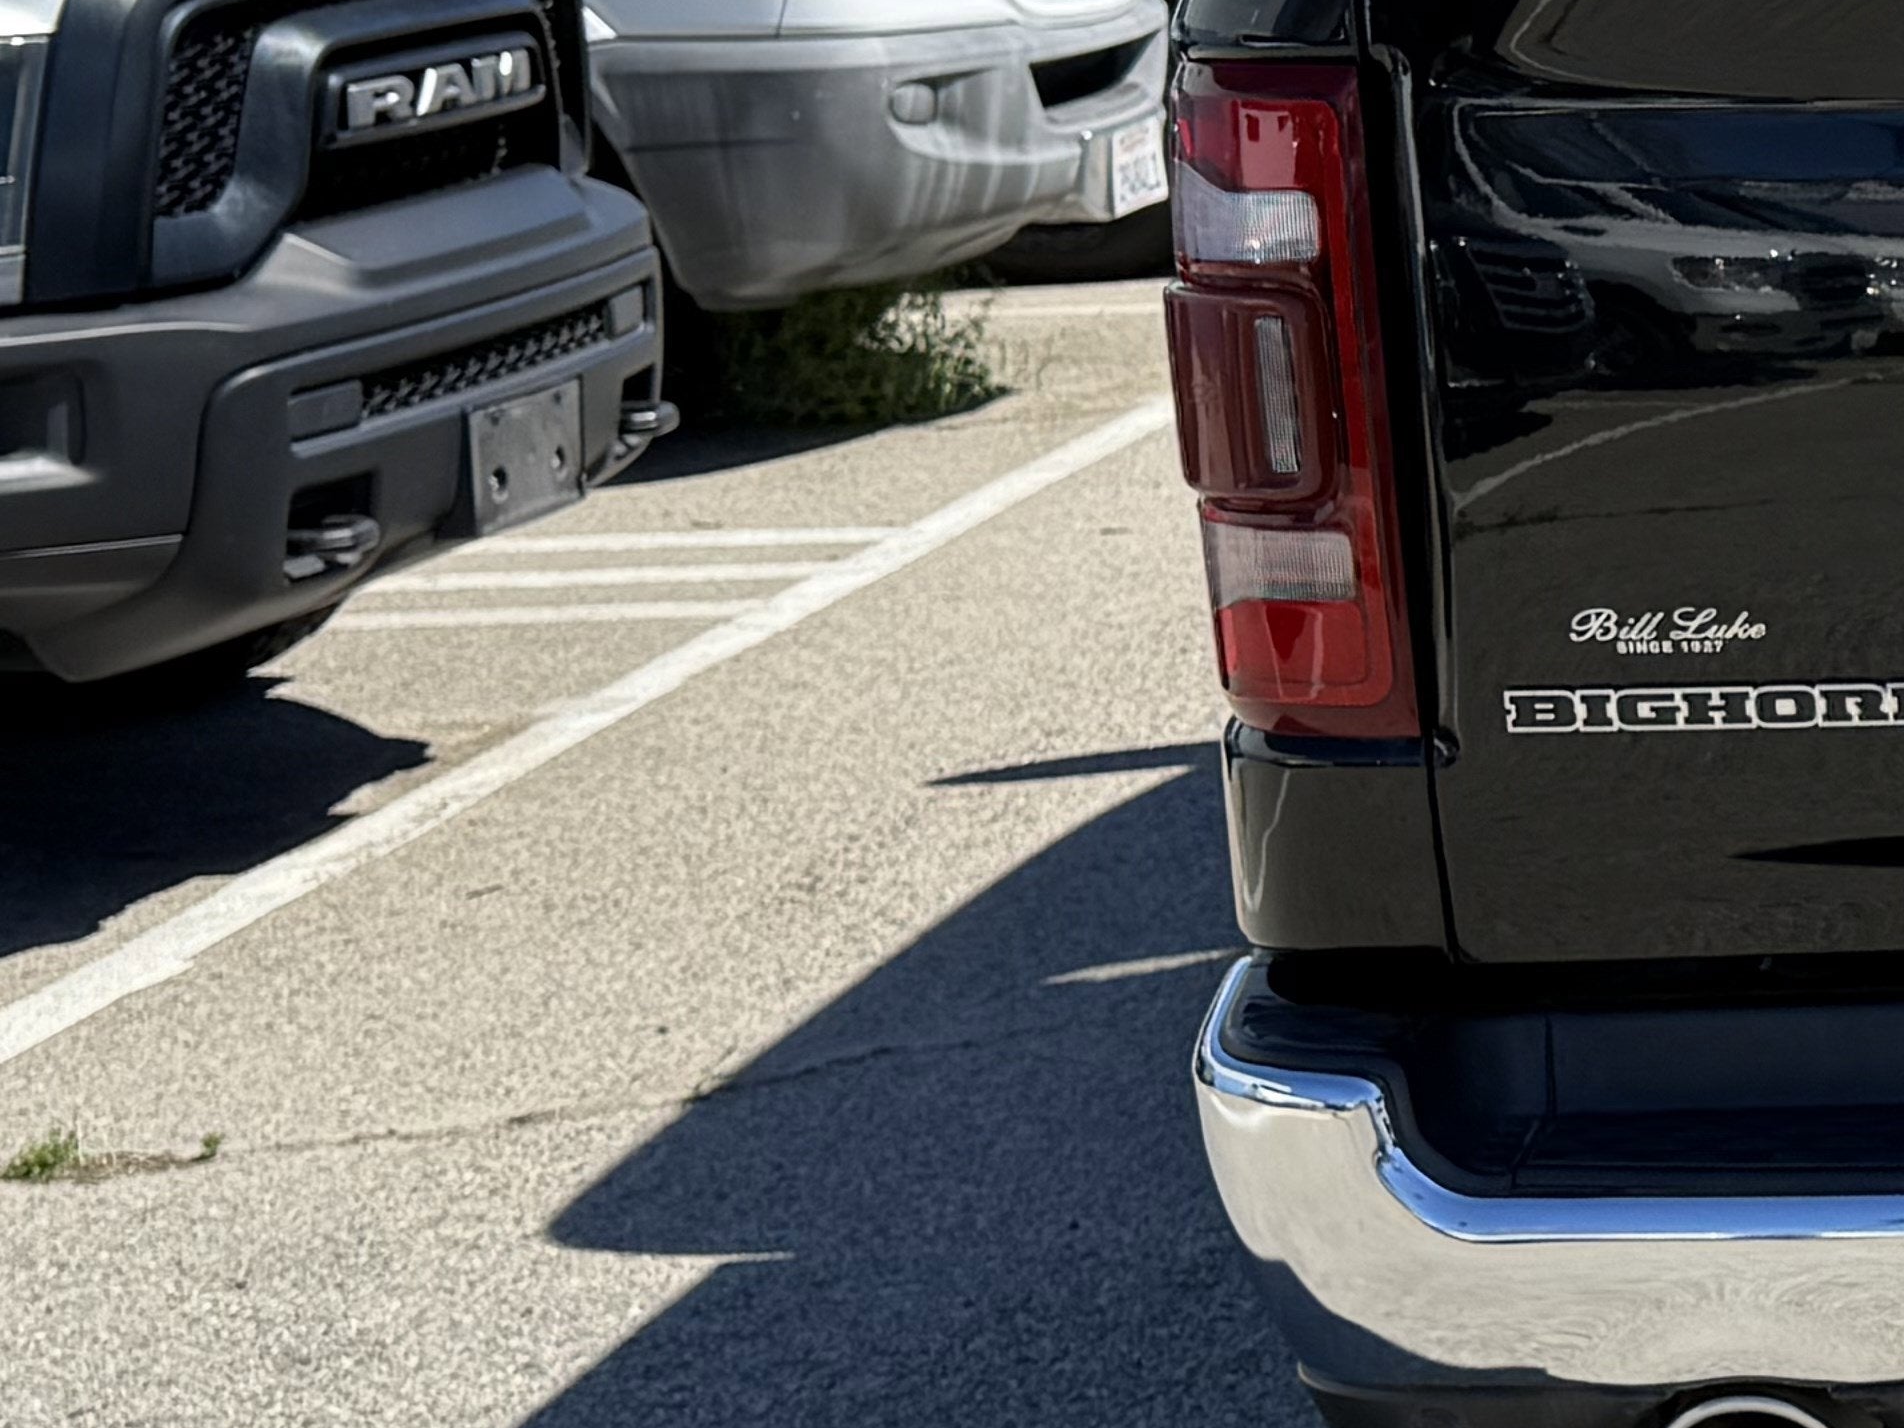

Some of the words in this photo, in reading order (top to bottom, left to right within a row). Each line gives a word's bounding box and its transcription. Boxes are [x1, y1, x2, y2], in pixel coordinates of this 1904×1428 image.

[347, 48, 532, 128] RAM
[1568, 606, 1665, 643] Bill
[1670, 606, 1767, 641] Luke
[1616, 639, 1675, 655] SINCE
